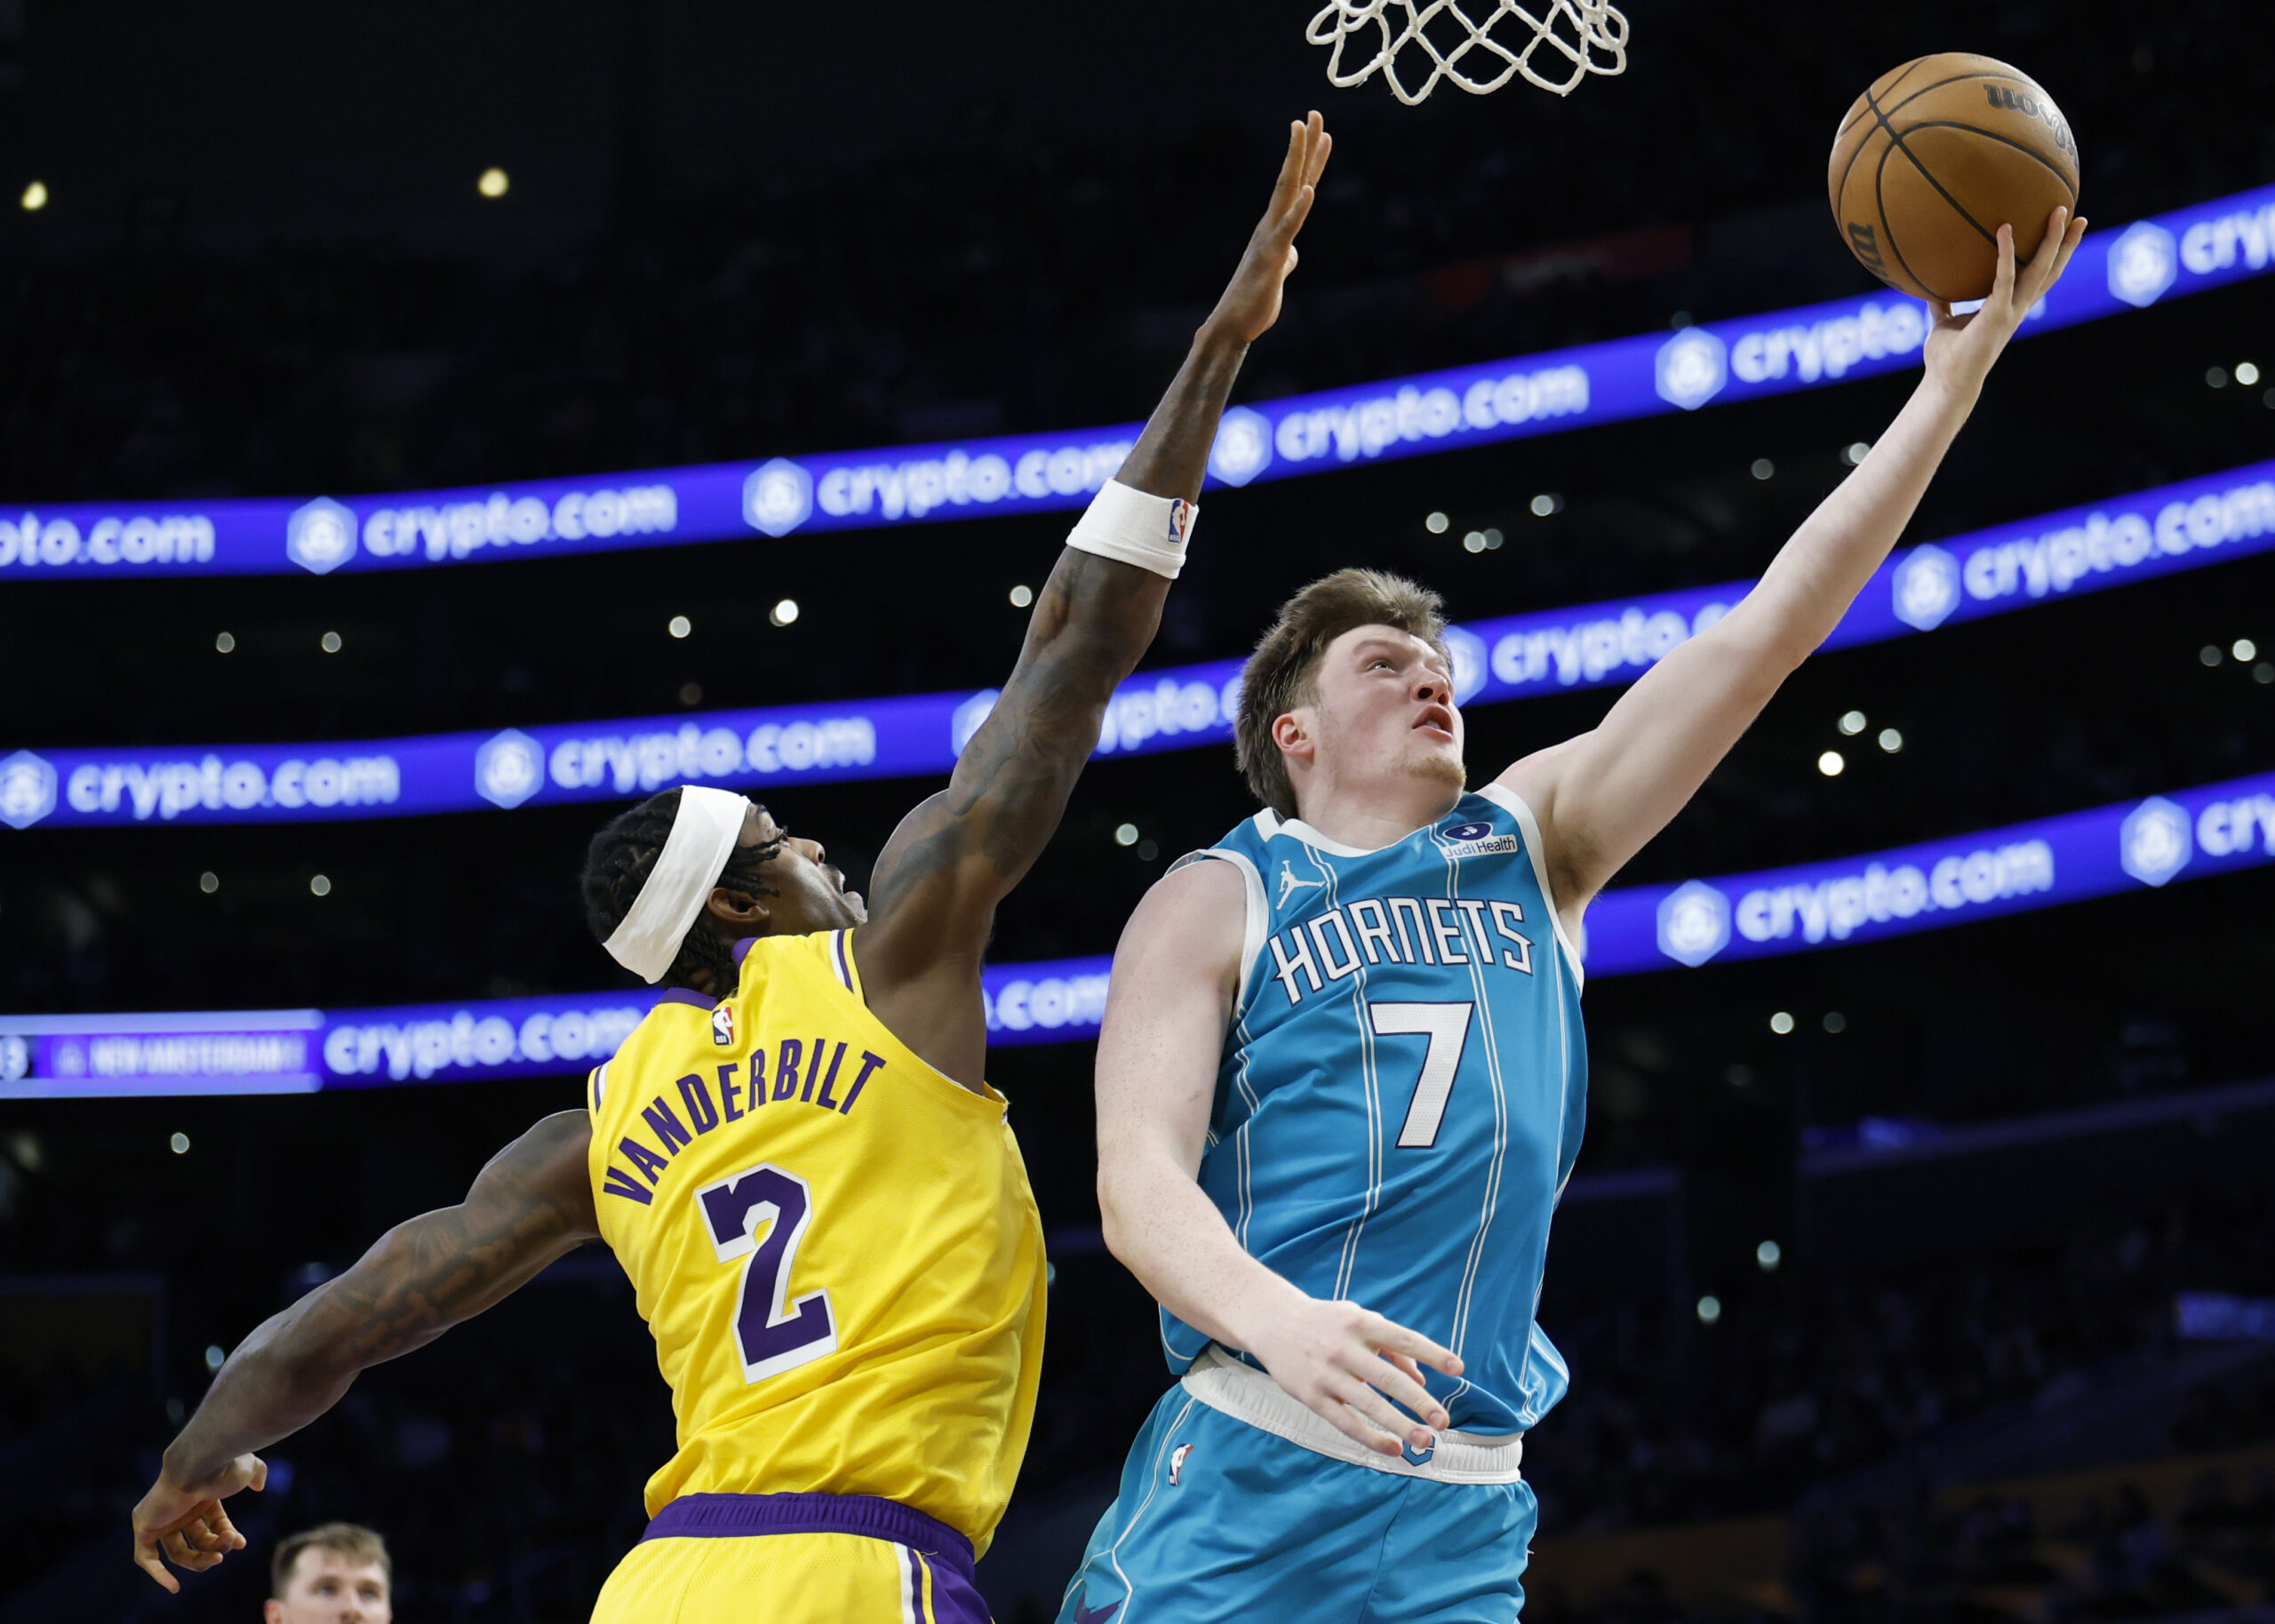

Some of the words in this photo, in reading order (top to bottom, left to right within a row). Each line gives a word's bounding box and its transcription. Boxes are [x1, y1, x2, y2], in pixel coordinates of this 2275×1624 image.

[1731, 299, 1936, 383] crypto
[1275, 364, 1590, 462] crypto.com
[363, 484, 678, 561] crypto.com
[1963, 482, 2275, 599] crypto.com
[68, 752, 401, 820] crypto.com
[549, 716, 876, 793] crypto.com
[1446, 843, 1475, 857] Judi
[1476, 837, 1515, 853] Health
[1736, 840, 2055, 943] crypto.com
[1269, 896, 1535, 1006] HORNETS
[603, 1038, 887, 1206] VANDERBILT
[1369, 1000, 1476, 1149] 7
[694, 1161, 838, 1385] 2
